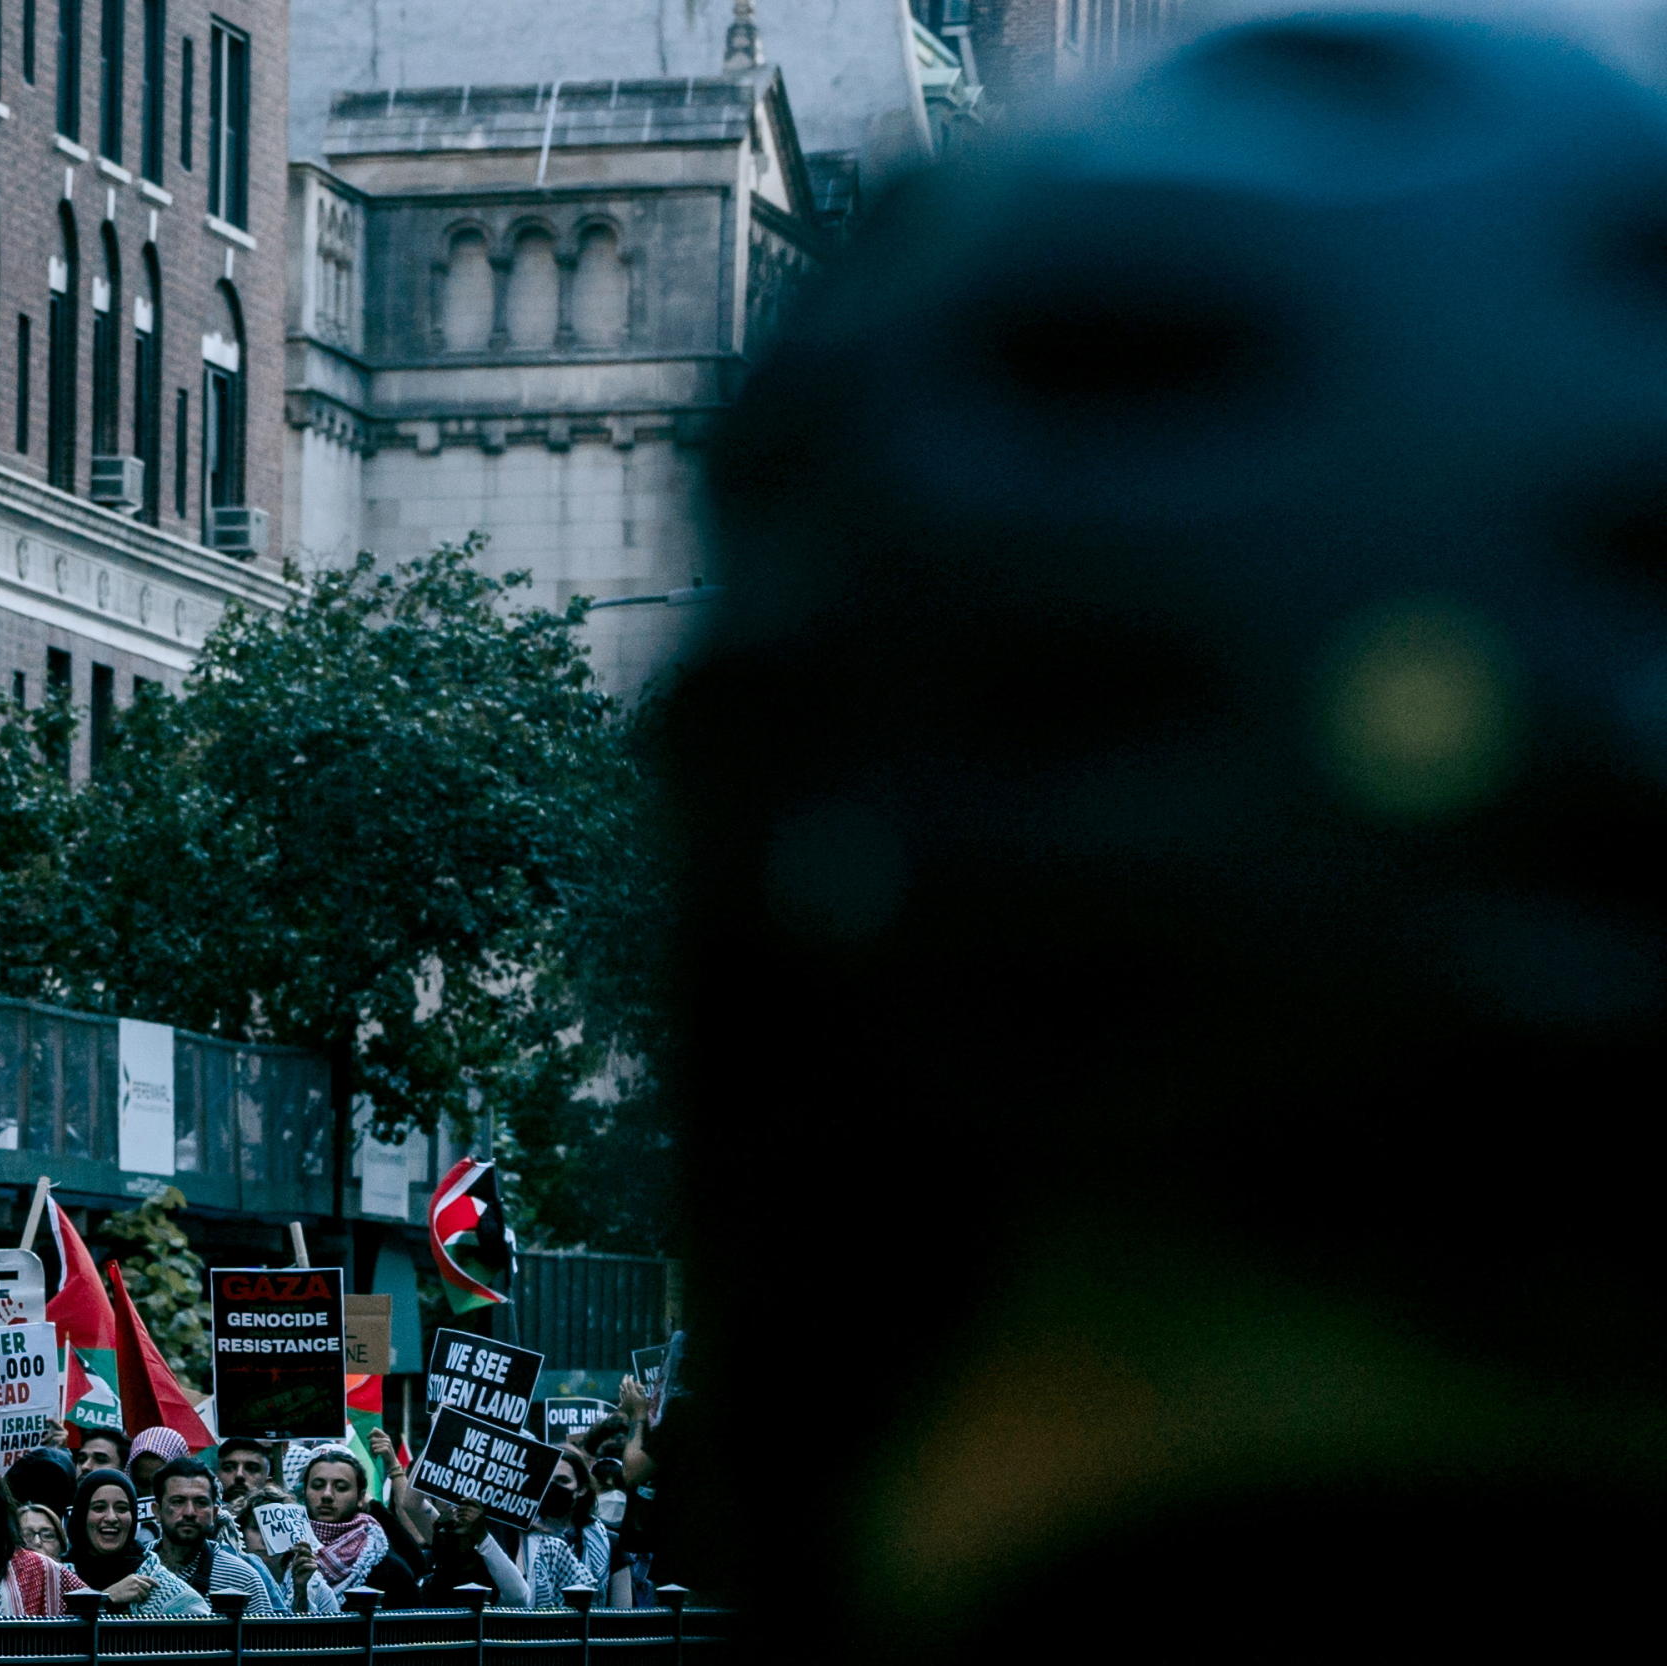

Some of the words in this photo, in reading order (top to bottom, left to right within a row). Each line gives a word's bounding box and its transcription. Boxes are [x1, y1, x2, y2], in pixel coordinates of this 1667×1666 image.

[221, 1274, 332, 1301] GAZA
[227, 1311, 329, 1328] GENOCIDE
[217, 1337, 340, 1354] RESISTANCE
[445, 1342, 473, 1373] WE
[471, 1349, 512, 1384] SEE
[427, 1373, 476, 1409] STOLEN
[474, 1386, 527, 1425] LAND
[2, 1414, 50, 1434] ISRAEL
[548, 1408, 578, 1425] OUR
[462, 1427, 491, 1451] WE
[489, 1437, 528, 1470] WILL
[448, 1446, 485, 1476] NOT
[482, 1462, 531, 1492] DENY
[420, 1459, 455, 1490] THIS
[452, 1472, 539, 1519] HOLOCAUST
[270, 1520, 306, 1537] MUST
